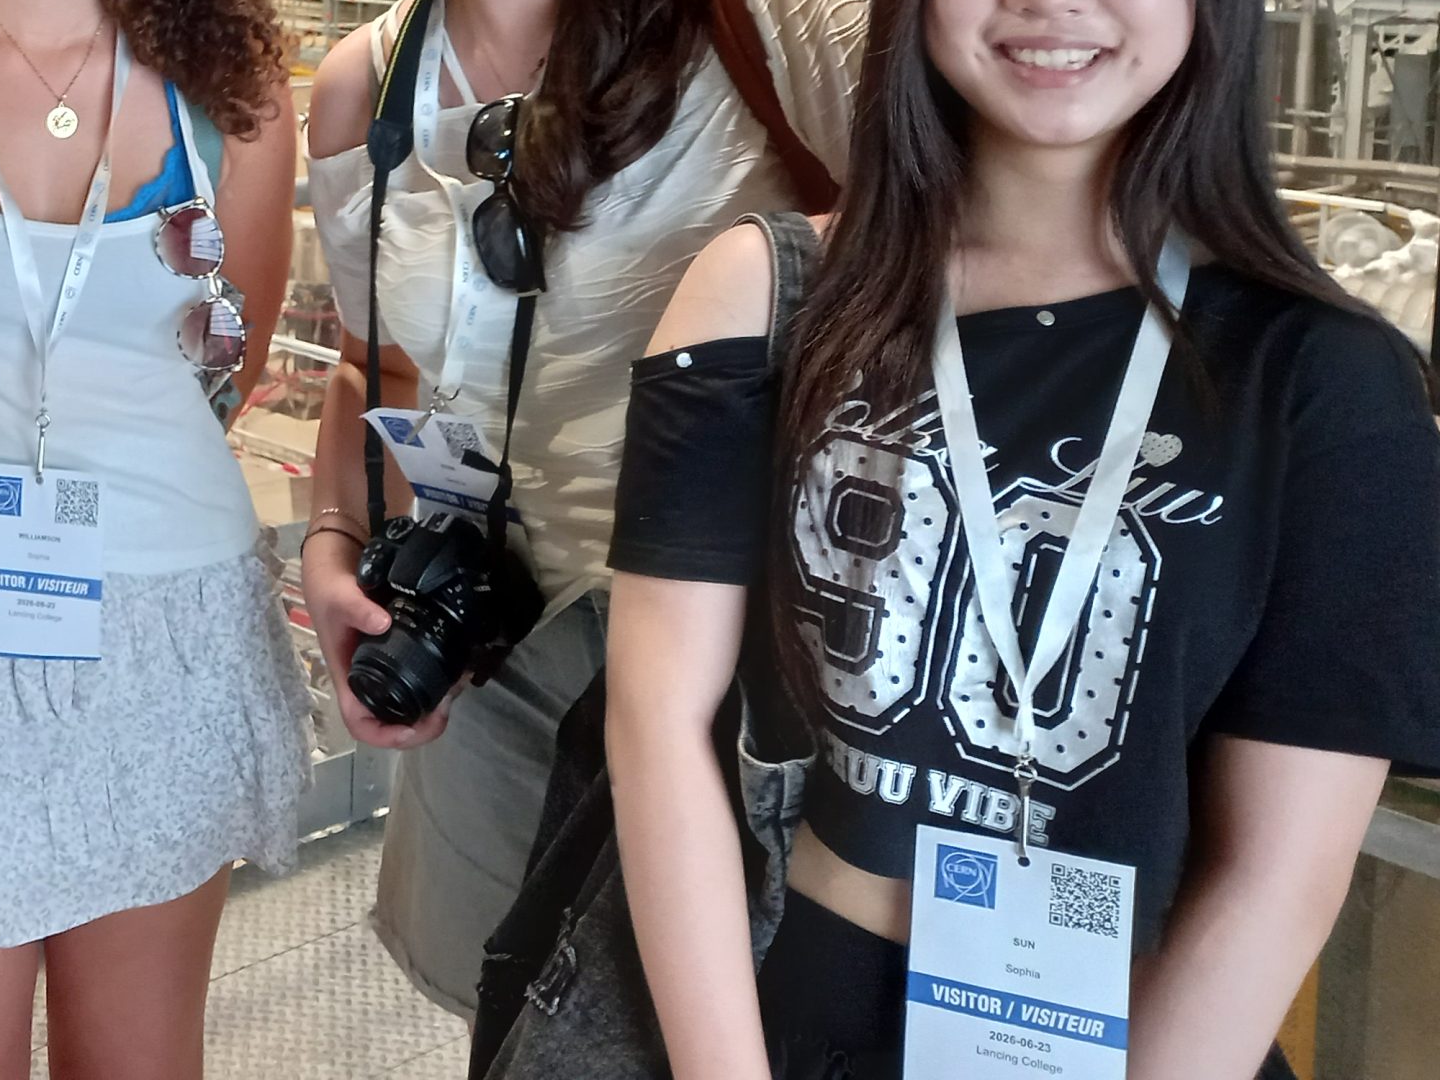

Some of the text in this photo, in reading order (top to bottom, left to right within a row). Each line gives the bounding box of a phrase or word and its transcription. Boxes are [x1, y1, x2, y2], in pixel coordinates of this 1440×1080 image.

[28, 577, 35, 591] /
[36, 577, 90, 596] VISITEUR
[792, 425, 1163, 792] 90
[927, 769, 1057, 848] VIBE
[1013, 937, 1036, 951] SUN
[1005, 963, 1041, 981] Sophia
[932, 983, 1105, 1039] VISITOR / VISITEUR
[989, 1030, 1052, 1054] 2026-06-23
[976, 1045, 1064, 1076] Lancing College
